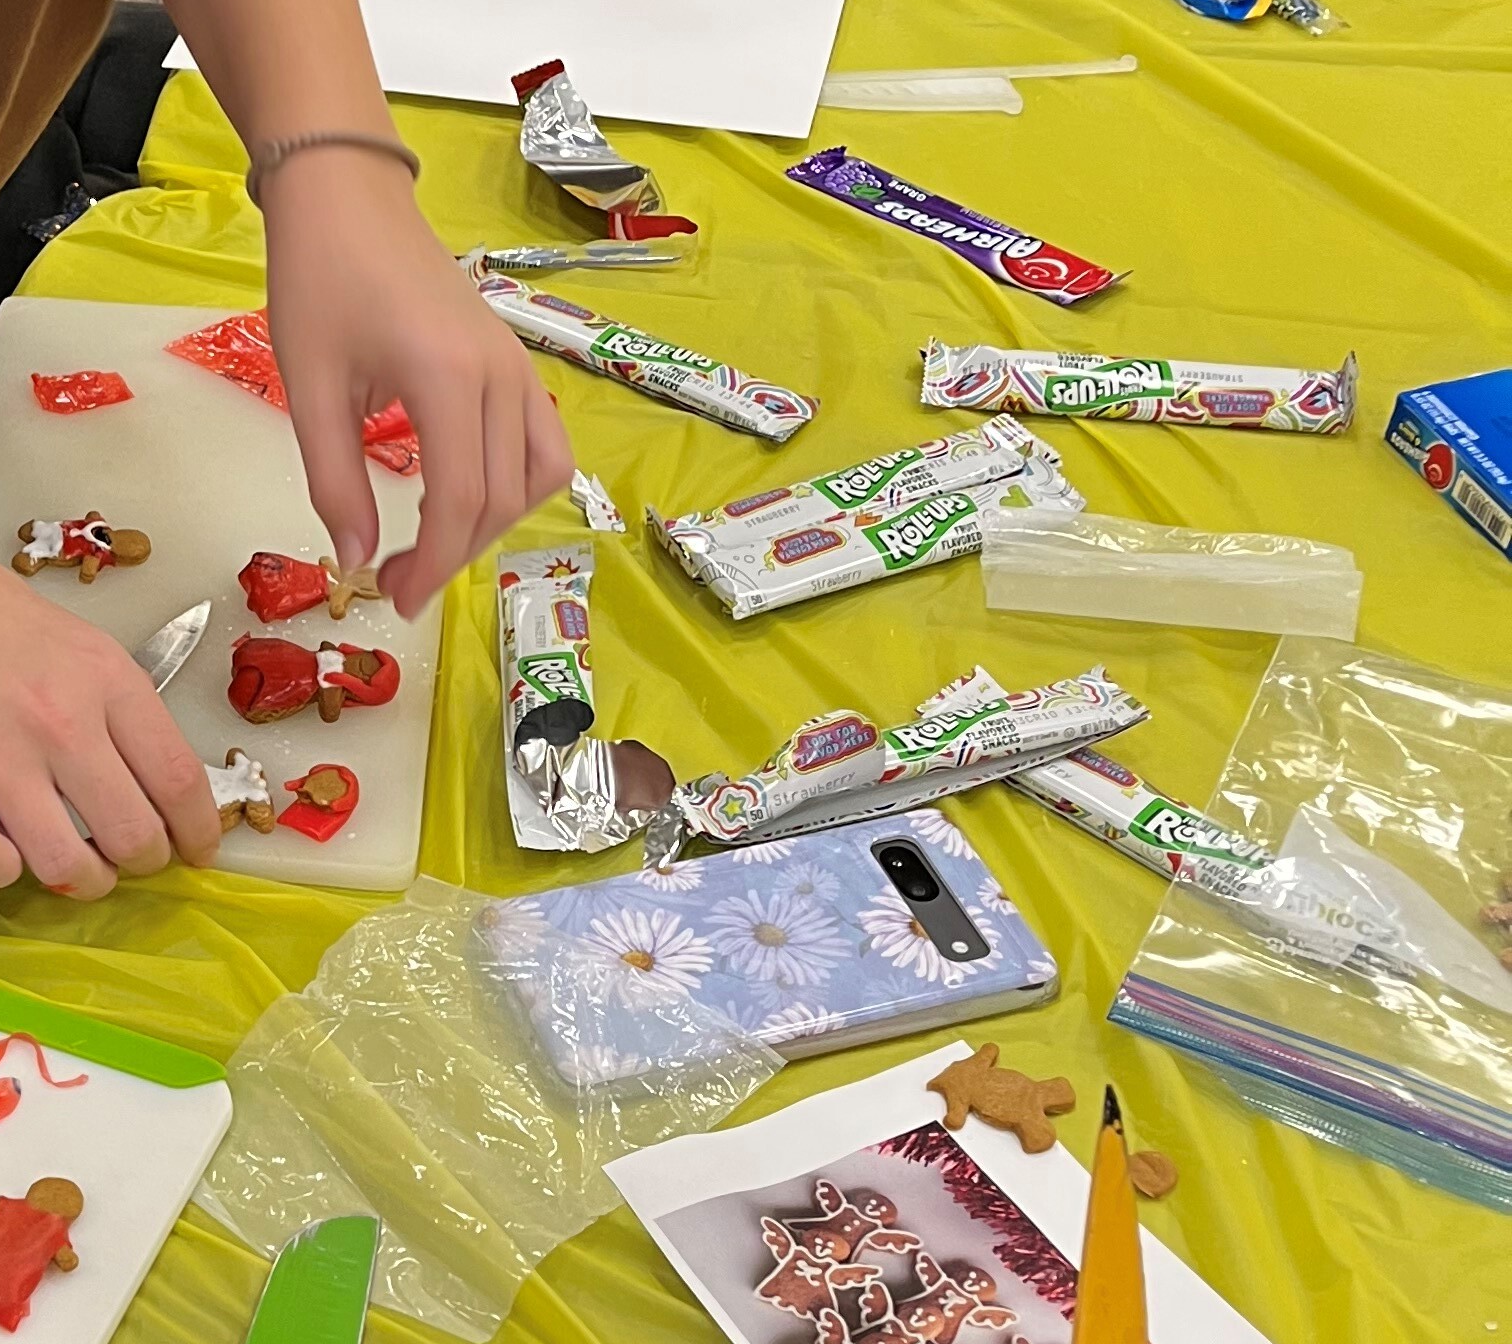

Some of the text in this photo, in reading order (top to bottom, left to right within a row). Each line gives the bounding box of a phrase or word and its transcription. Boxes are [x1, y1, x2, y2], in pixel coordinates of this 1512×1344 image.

[887, 178, 927, 202] GRAPE
[874, 200, 1045, 259] AIRHEADS
[647, 373, 681, 393] SNACKS
[905, 477, 940, 494] SNACKS
[743, 503, 802, 529] STRAWBERRY
[954, 521, 979, 536] FRUIT
[941, 531, 983, 552] FLAVORED
[951, 542, 983, 557] SNACKS
[810, 568, 863, 593] Strawberry
[804, 724, 857, 750] LOOK FOR
[966, 722, 1018, 742] FLAVORED
[981, 733, 1022, 751] SNACKS
[773, 771, 856, 807] Strawberry
[750, 807, 764, 821] 50
